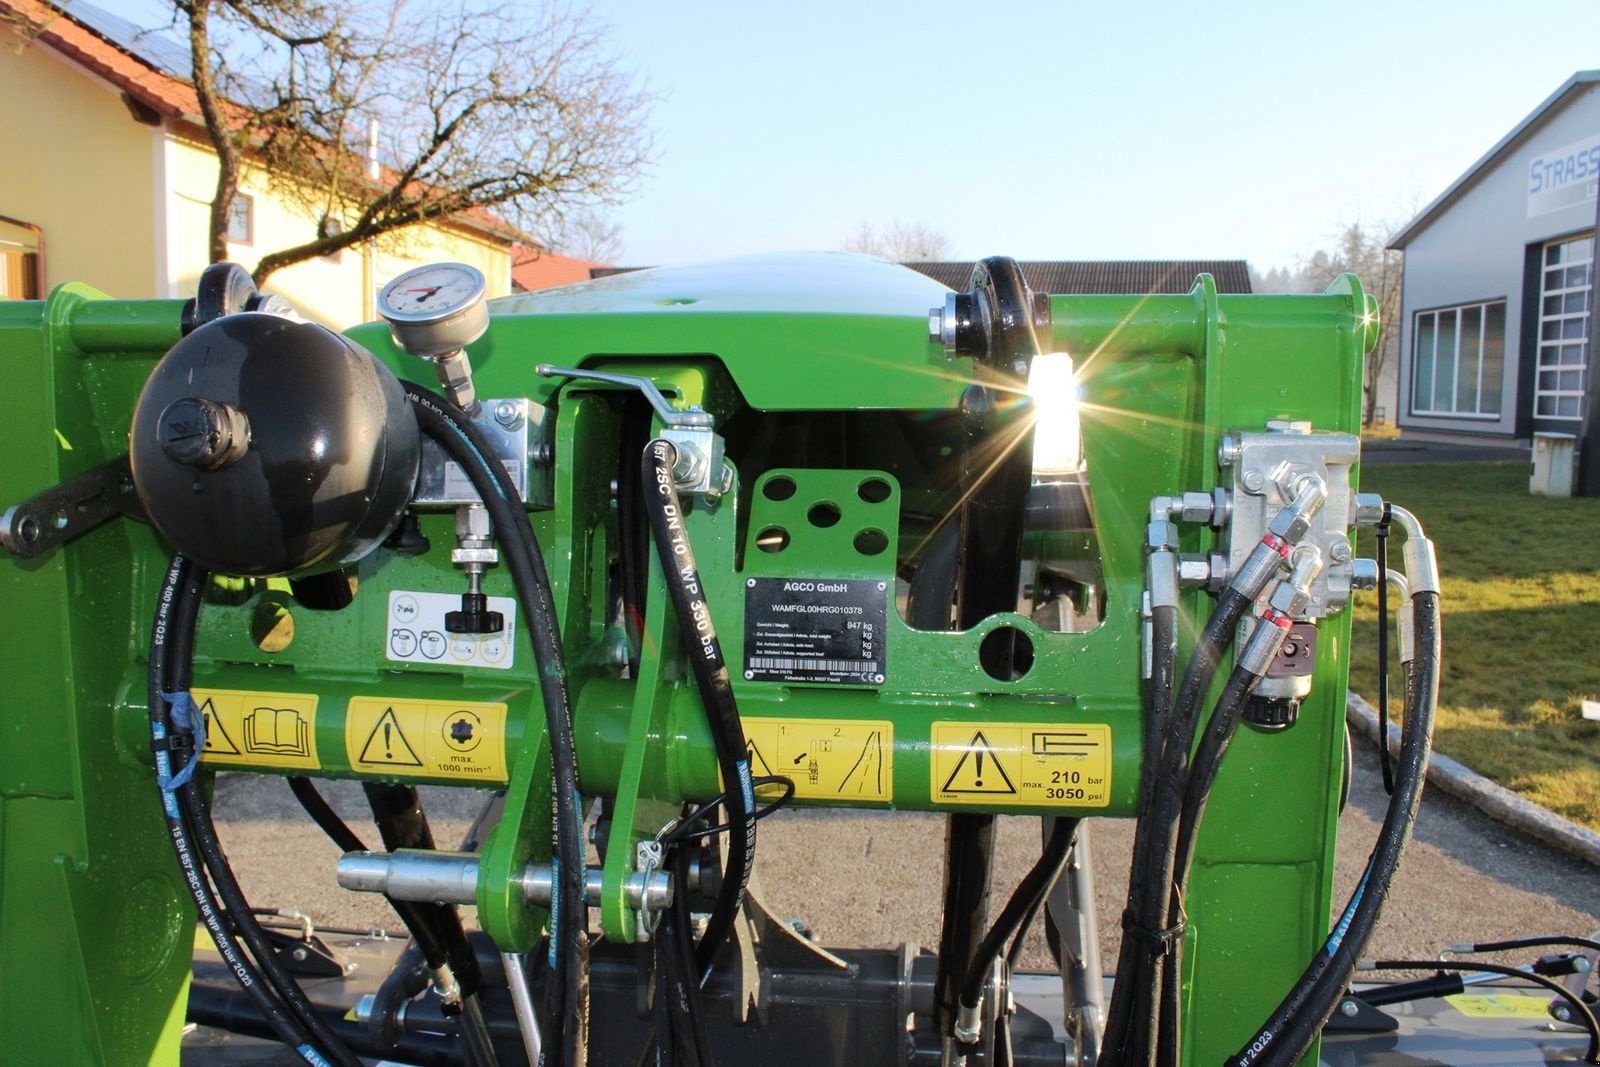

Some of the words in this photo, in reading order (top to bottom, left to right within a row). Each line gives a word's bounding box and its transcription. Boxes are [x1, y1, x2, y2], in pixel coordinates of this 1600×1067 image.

[656, 466, 672, 495] 2SC
[663, 505, 680, 530] DN
[671, 532, 686, 555] 10
[169, 569, 180, 585] WP
[680, 567, 699, 595] WP
[163, 585, 174, 602] 400
[783, 582, 815, 592] AGCO
[817, 583, 848, 593] GmbH
[159, 603, 170, 618] bar
[690, 600, 708, 631] 330
[771, 604, 863, 615] WAMFGL00HRG010378
[154, 619, 166, 645] 2Q23
[847, 621, 861, 630] 947
[863, 621, 873, 632] kg
[862, 630, 872, 639] kg
[701, 633, 717, 660] bar
[862, 640, 872, 650] kg
[862, 649, 872, 659] kg
[438, 764, 461, 772] 1000
[1051, 770, 1080, 784] 210
[1023, 781, 1045, 789] max.
[1046, 788, 1084, 799] 3050
[1088, 793, 1102, 801] psi
[172, 826, 183, 837] 15
[175, 838, 187, 852] EN
[180, 852, 193, 870] 857
[186, 870, 200, 890] 2SC
[194, 890, 207, 904] DN
[206, 916, 220, 932] WP
[223, 947, 236, 962] bar
[233, 963, 253, 987] 2Q23
[1247, 1030, 1273, 1059] 2Q23
